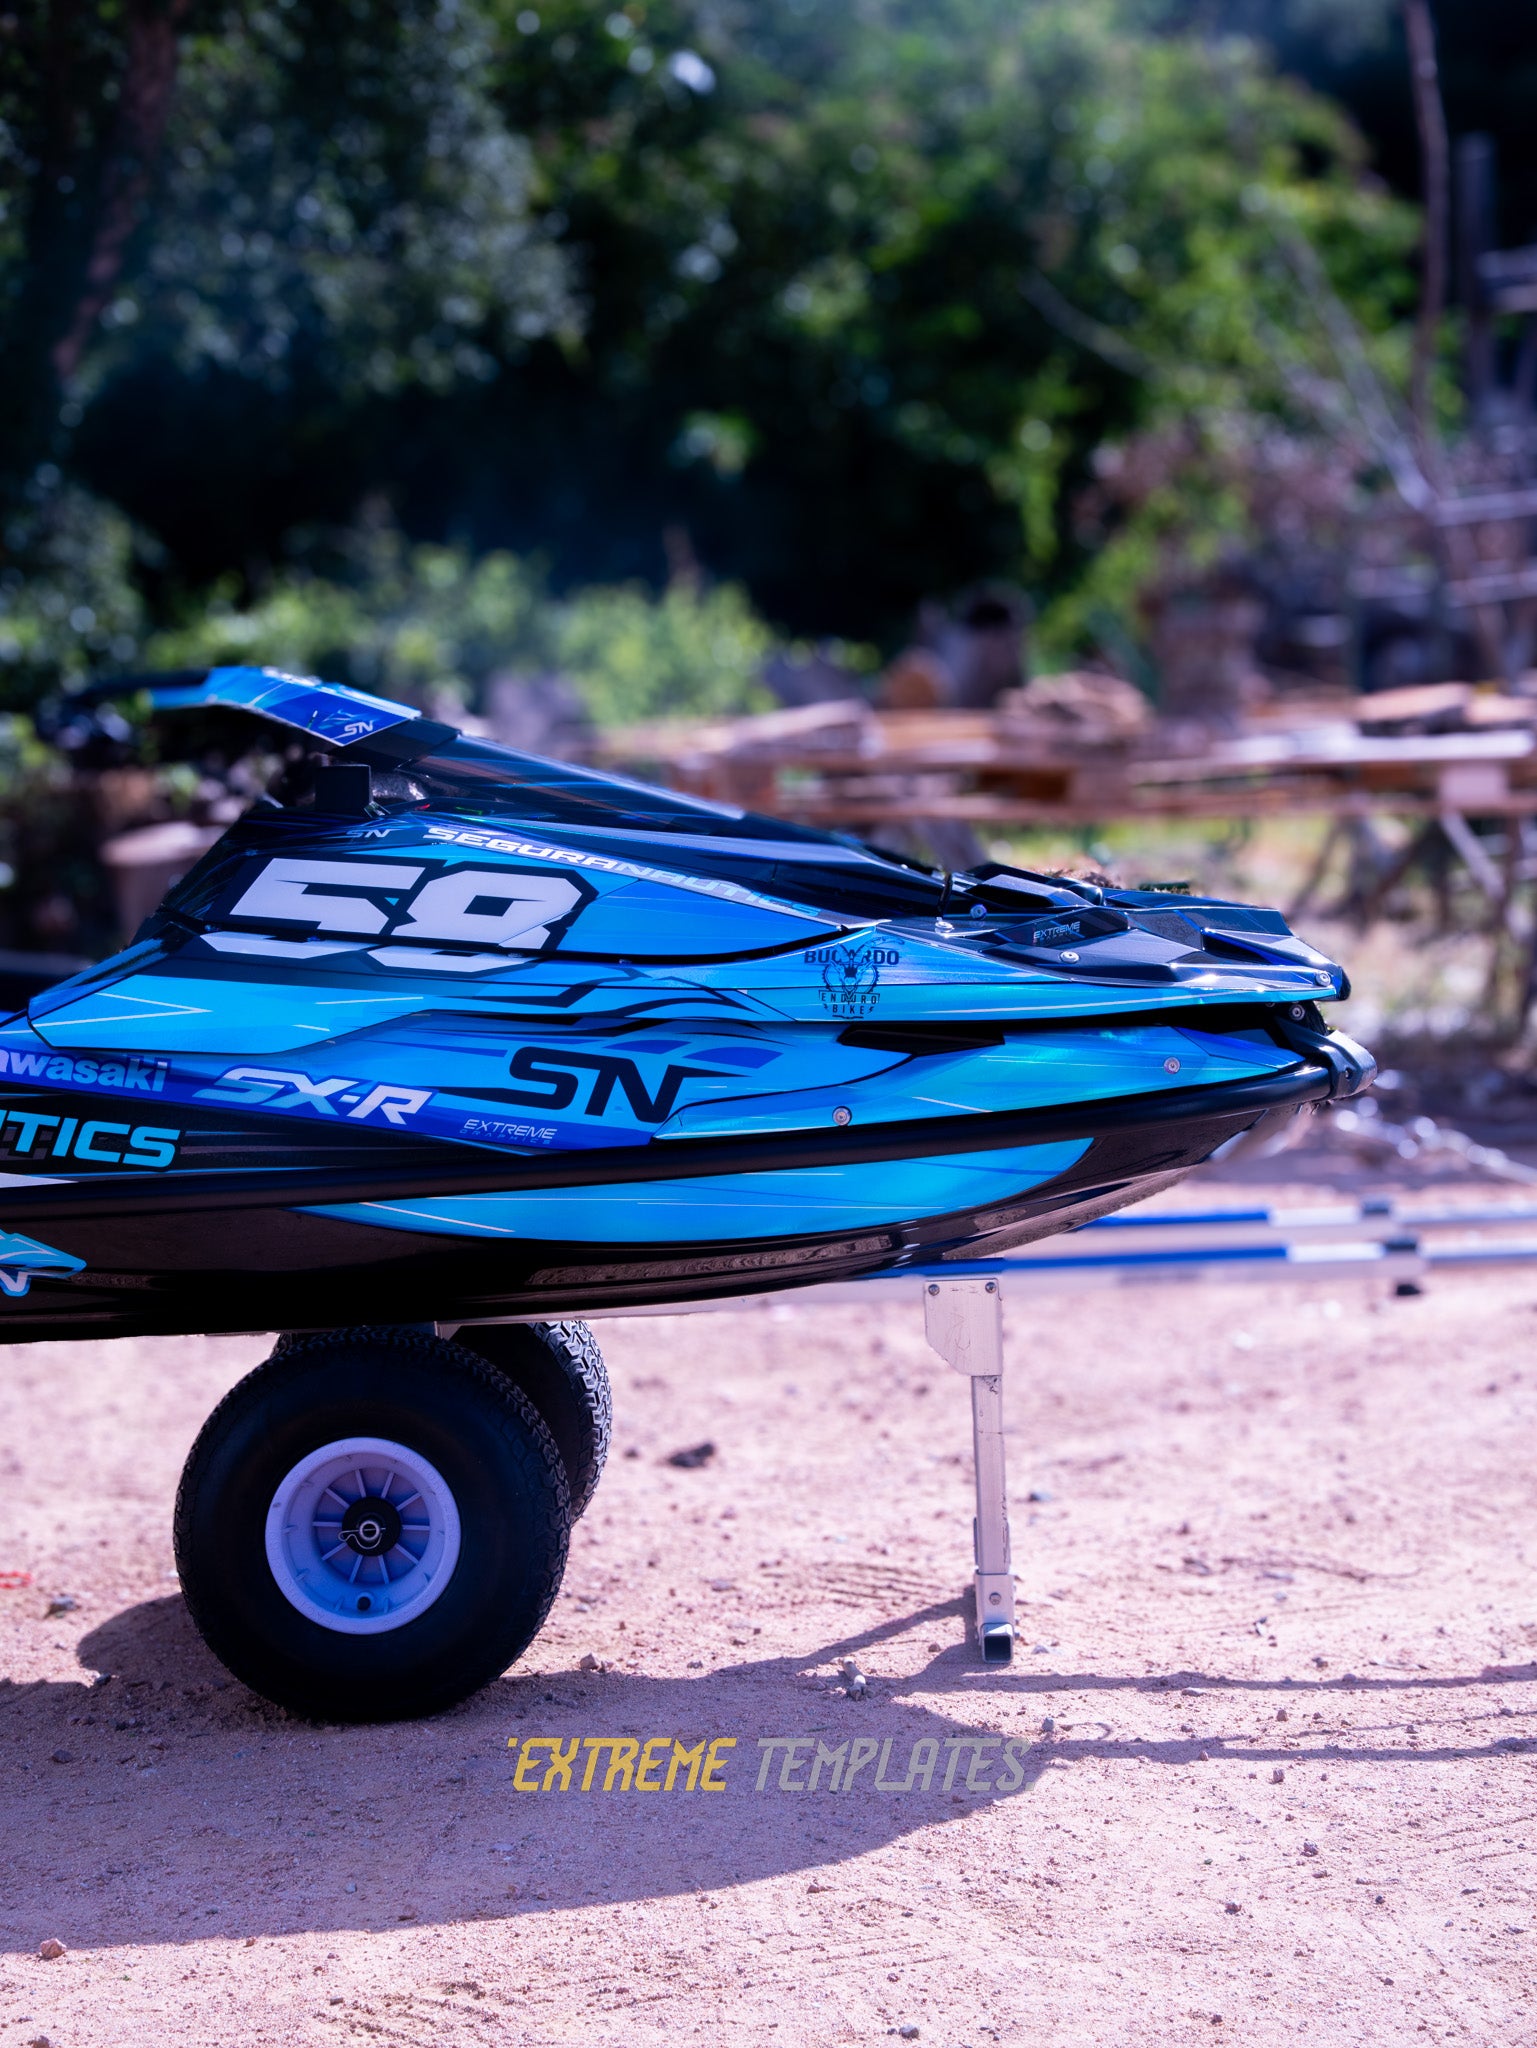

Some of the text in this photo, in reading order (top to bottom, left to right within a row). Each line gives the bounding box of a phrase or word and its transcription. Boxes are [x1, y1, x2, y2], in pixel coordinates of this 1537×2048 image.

[338, 720, 375, 737] SN
[199, 857, 583, 973] 58
[1033, 921, 1081, 939] EXTREME
[832, 1003, 865, 1015] BIKE
[192, 1067, 433, 1125] SX-R
[492, 1046, 722, 1124] SN
[0, 1110, 181, 1168] TICS
[463, 1119, 558, 1139] EXTREME
